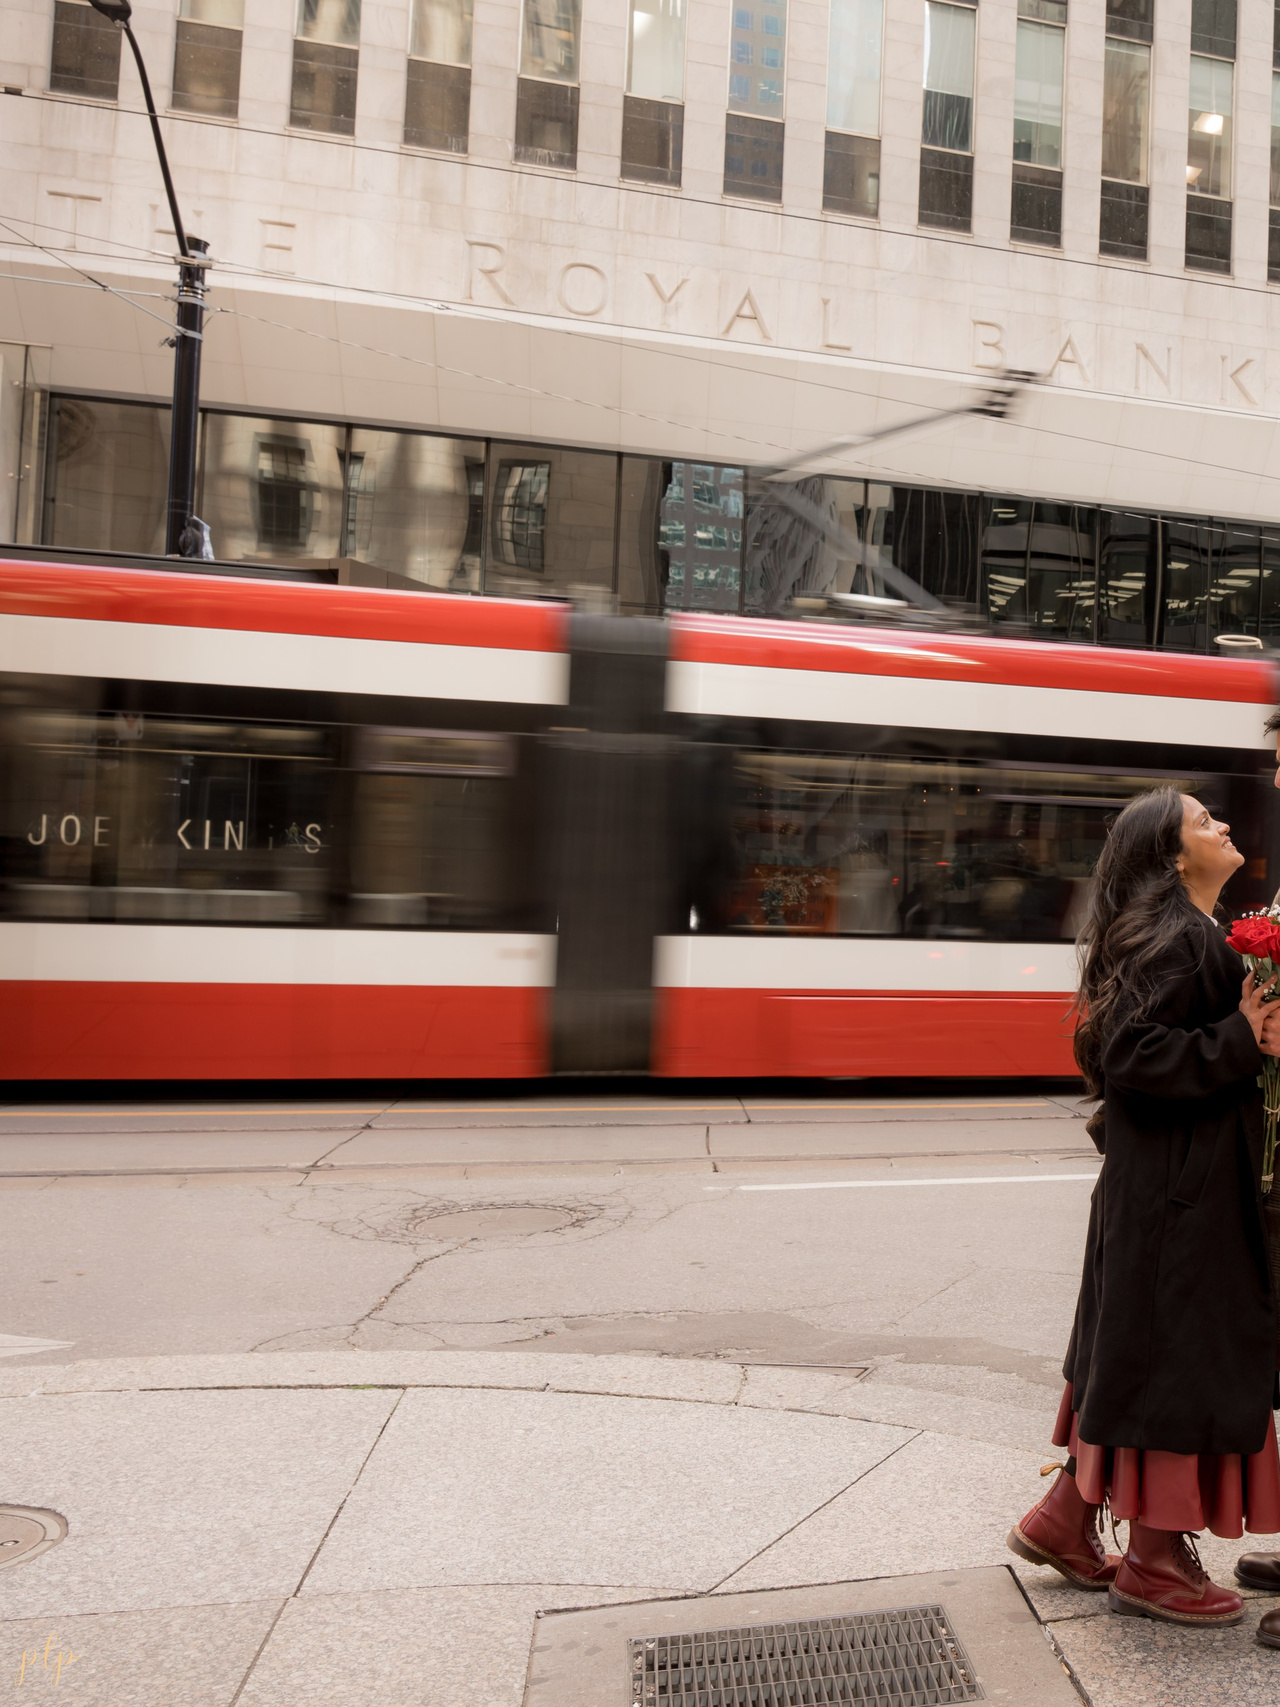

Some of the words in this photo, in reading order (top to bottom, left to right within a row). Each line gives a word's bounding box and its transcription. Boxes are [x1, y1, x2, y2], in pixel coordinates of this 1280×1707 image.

[464, 239, 852, 351] ROYAL
[971, 319, 1259, 406] BANK
[27, 814, 114, 846] JOE
[176, 818, 273, 851] KIN
